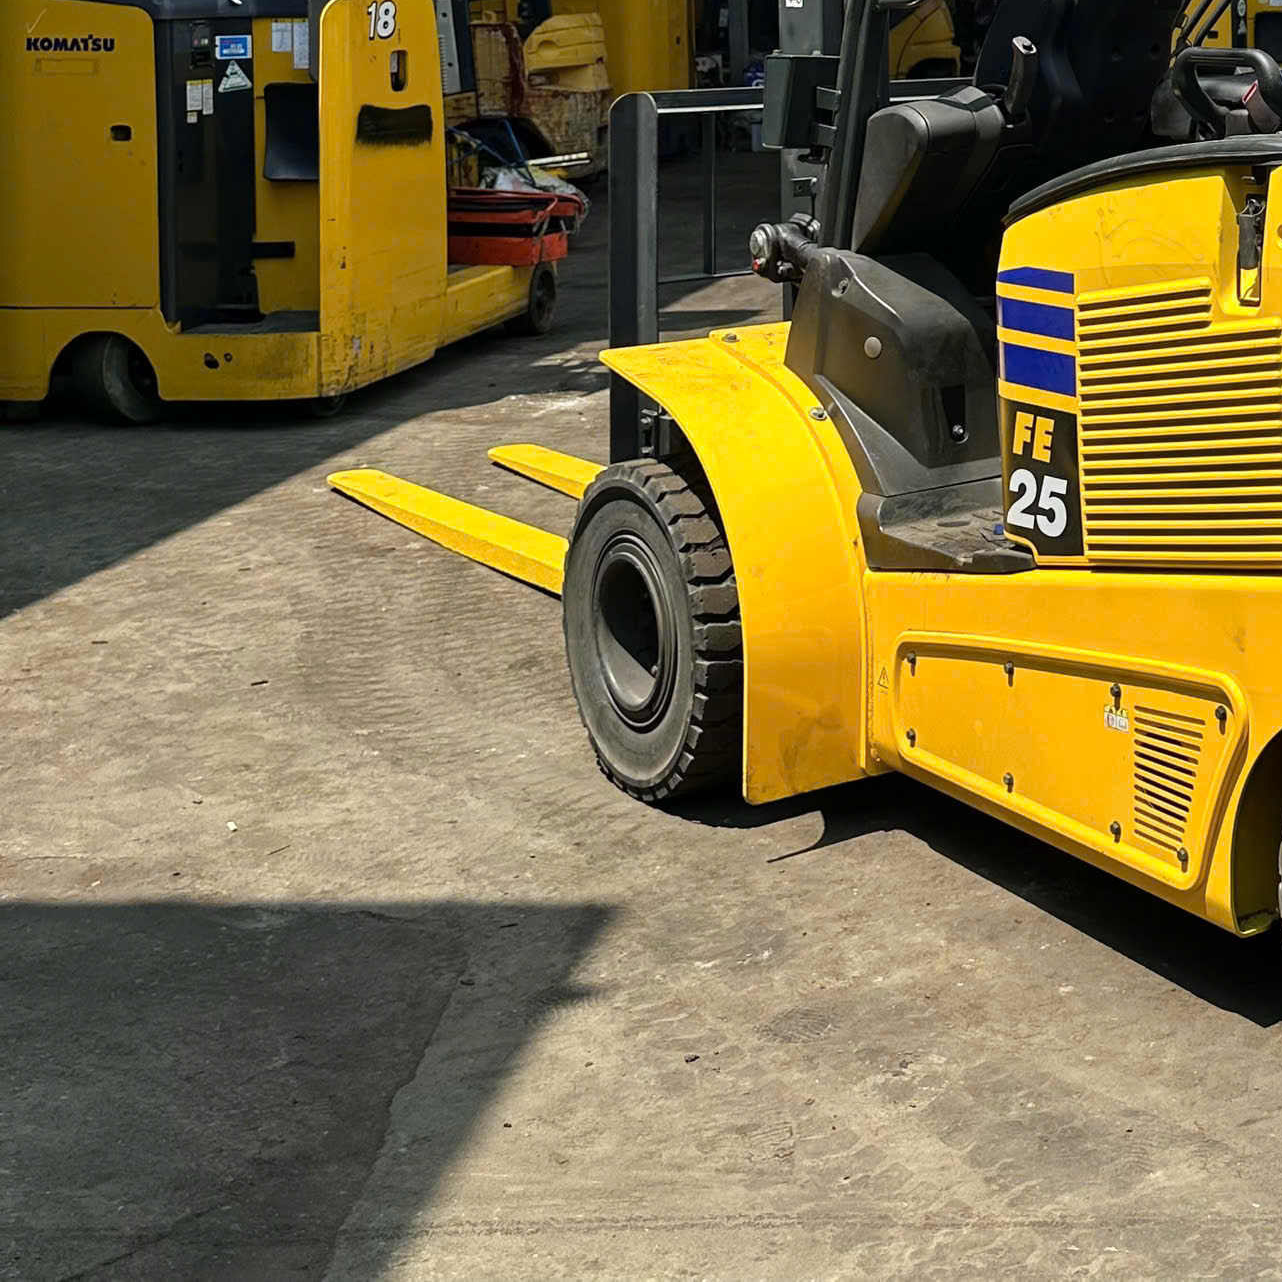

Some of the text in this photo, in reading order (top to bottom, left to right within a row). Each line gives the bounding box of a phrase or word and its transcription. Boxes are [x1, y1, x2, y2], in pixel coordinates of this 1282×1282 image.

[26, 34, 115, 52] KOMATSU
[367, 0, 397, 40] 18
[1012, 411, 1055, 464] FE
[1006, 468, 1068, 538] 25
